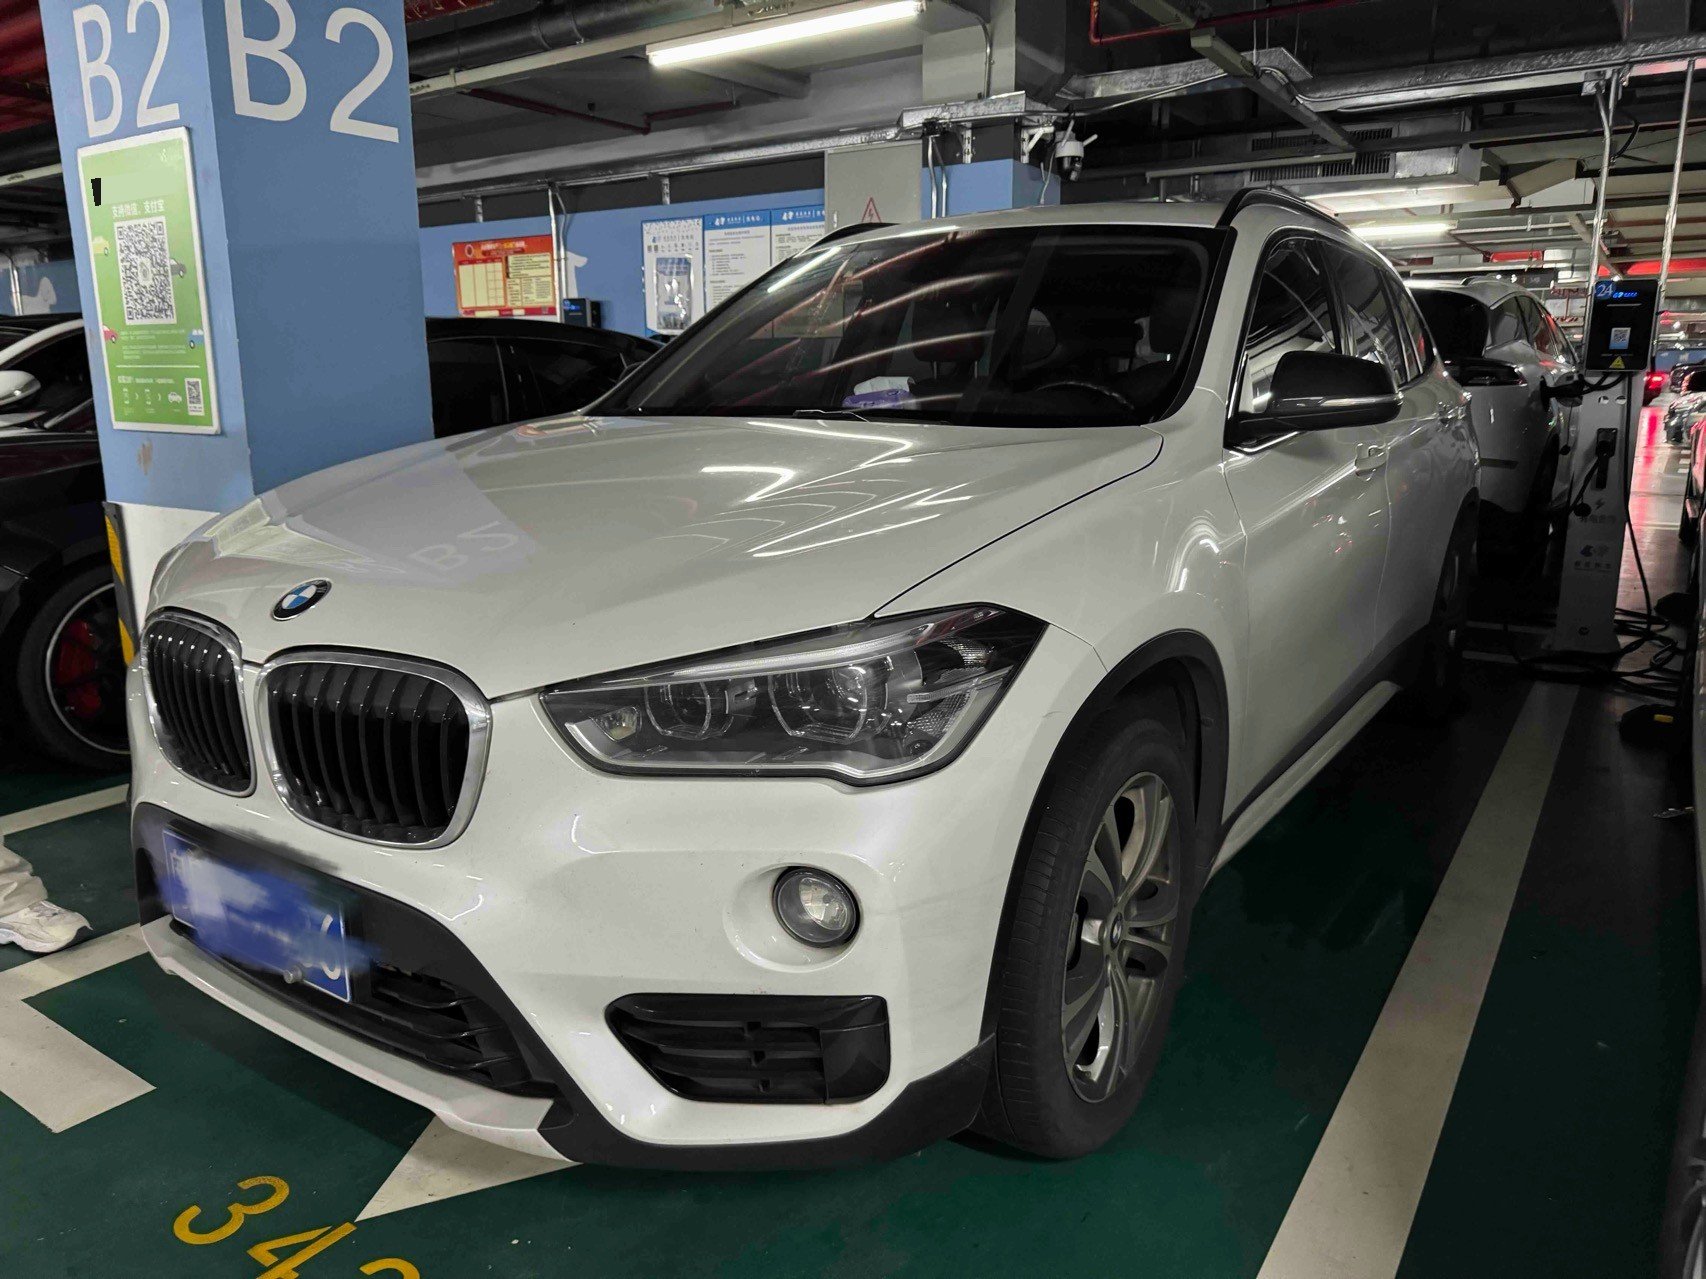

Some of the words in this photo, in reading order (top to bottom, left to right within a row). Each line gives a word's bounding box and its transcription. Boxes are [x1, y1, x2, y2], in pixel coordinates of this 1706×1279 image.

[73, 0, 180, 138] B2
[224, 0, 399, 143] B2
[1596, 283, 1613, 297] 24
